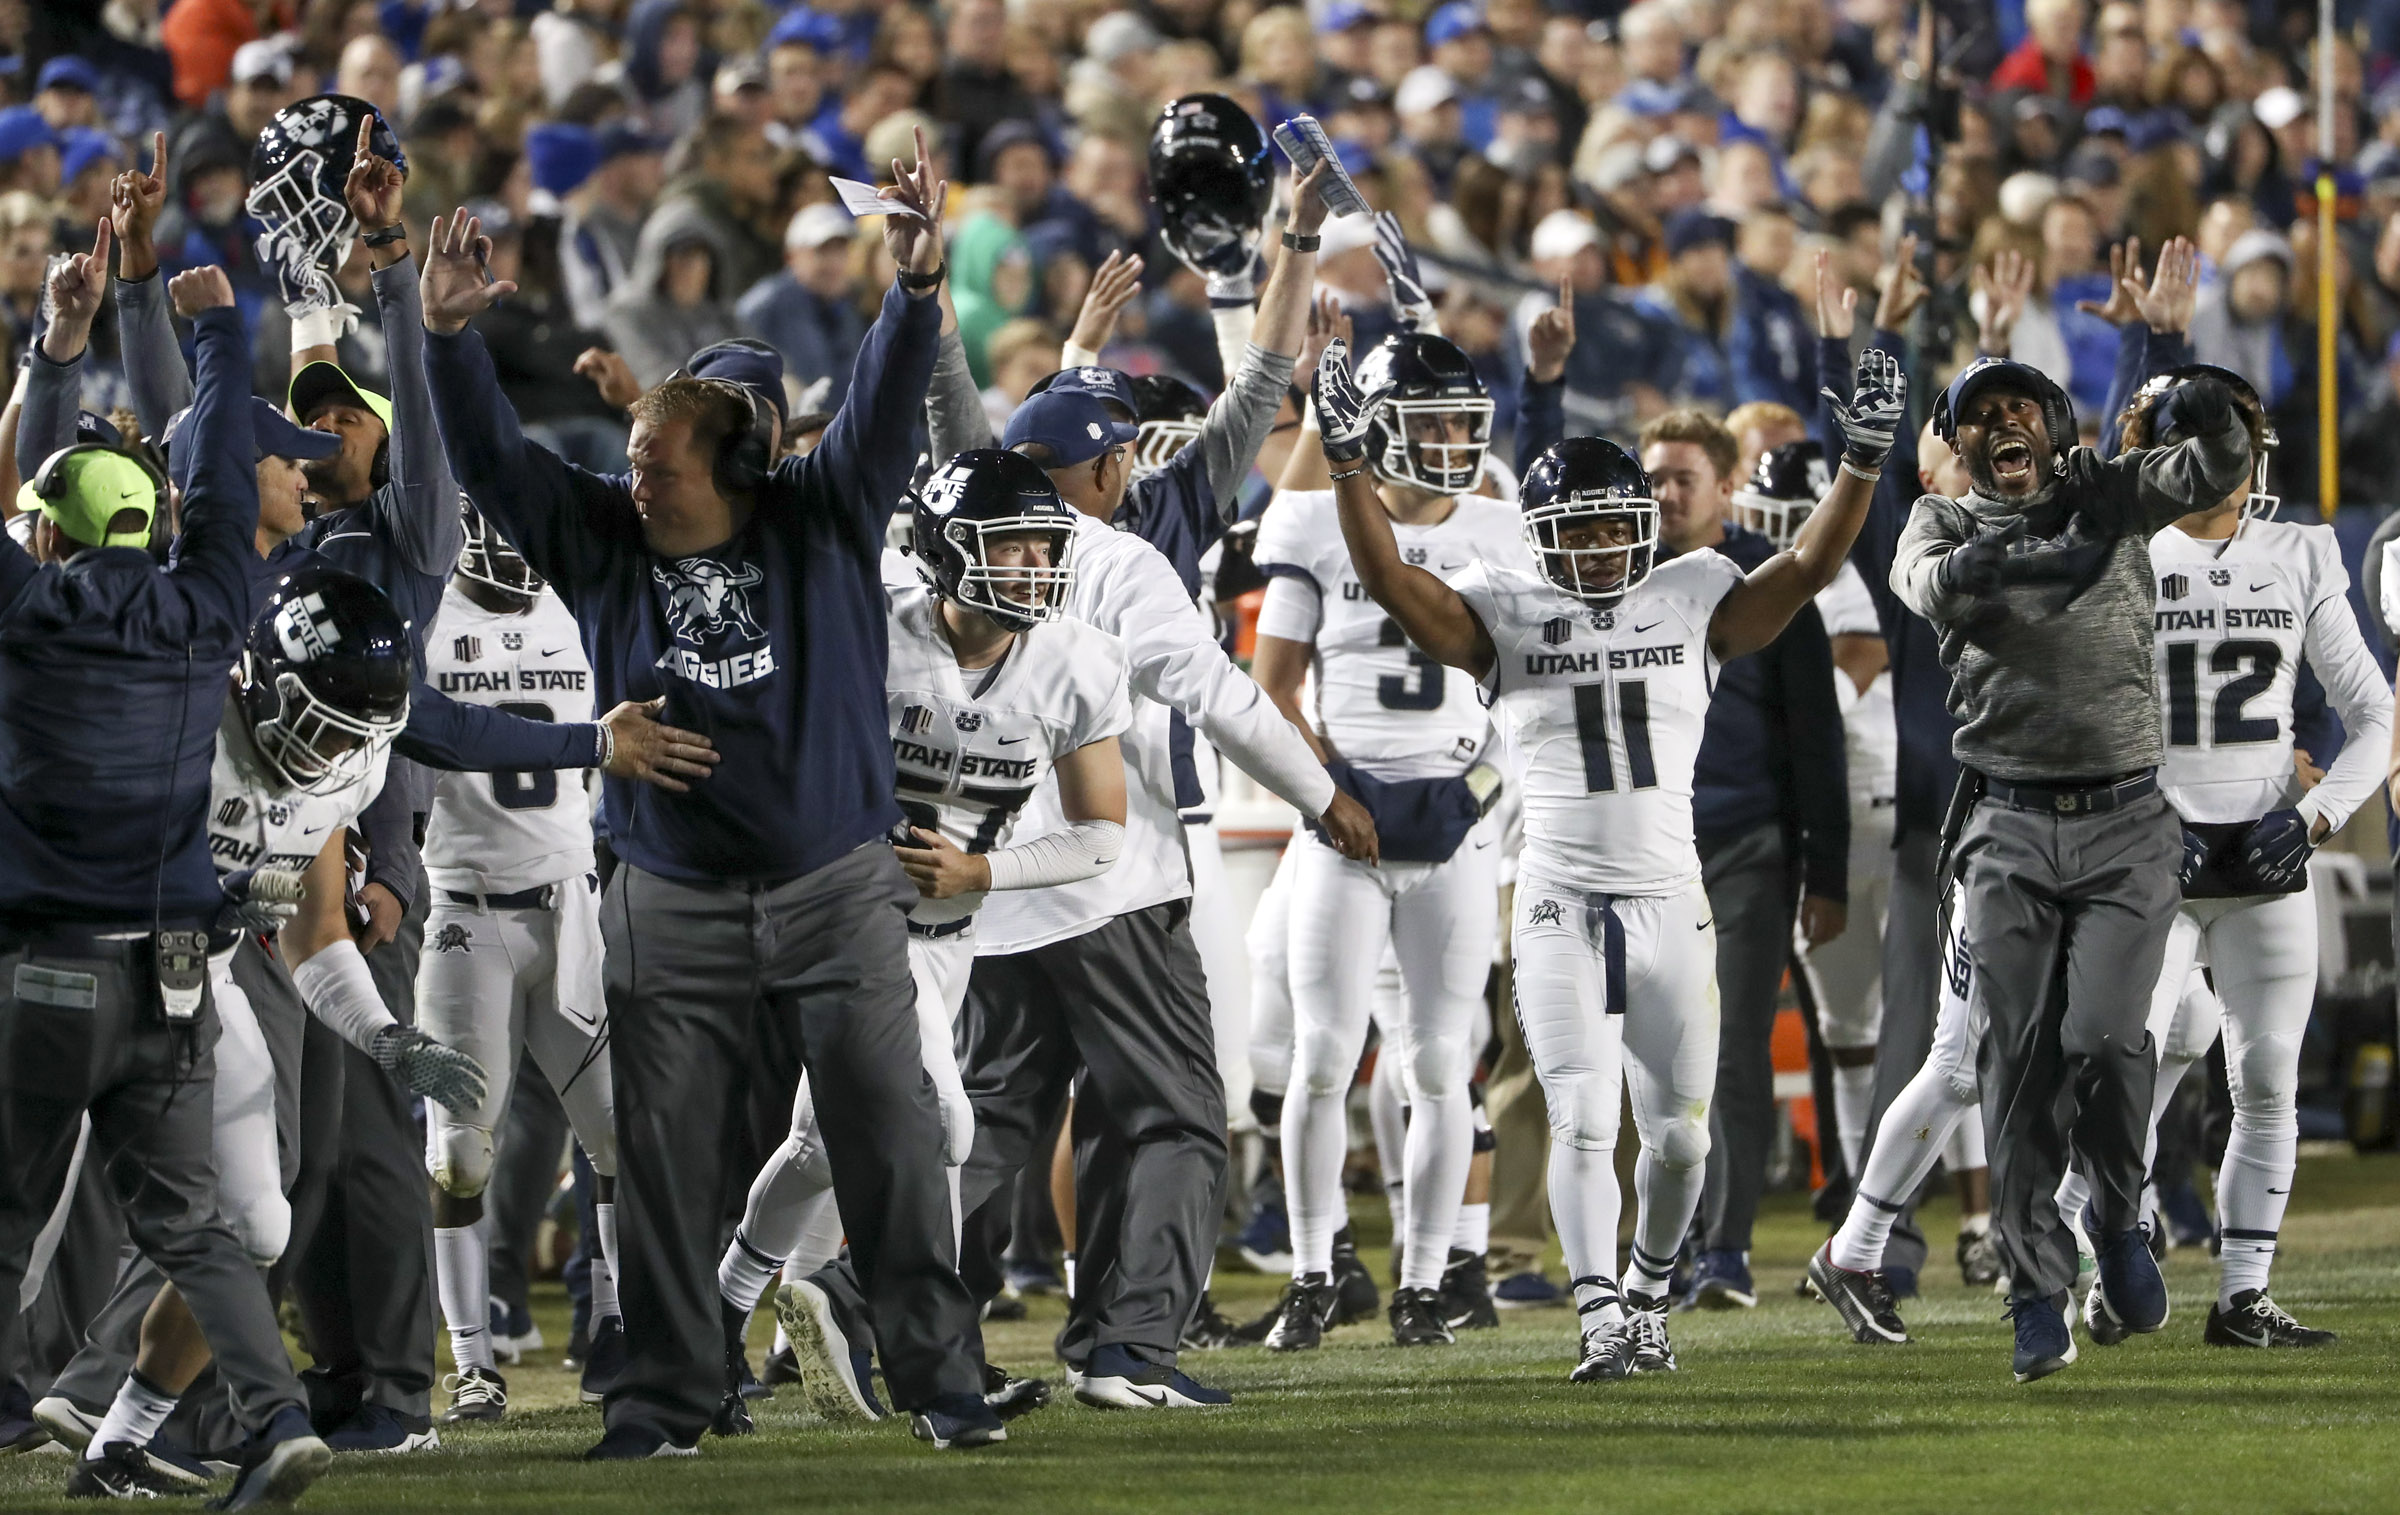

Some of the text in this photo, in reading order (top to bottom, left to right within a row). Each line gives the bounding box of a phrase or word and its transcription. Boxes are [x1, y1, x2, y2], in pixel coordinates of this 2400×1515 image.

[2225, 608, 2293, 630] STATE
[654, 645, 775, 690] AGGIES
[1378, 616, 1445, 711] 3
[1526, 644, 1685, 675] UTAH STATE
[440, 670, 587, 692] UTAH STATE
[2165, 637, 2284, 748] 12
[1570, 677, 1660, 796] 11
[959, 754, 1038, 779] STATE
[208, 832, 264, 866] TAH
